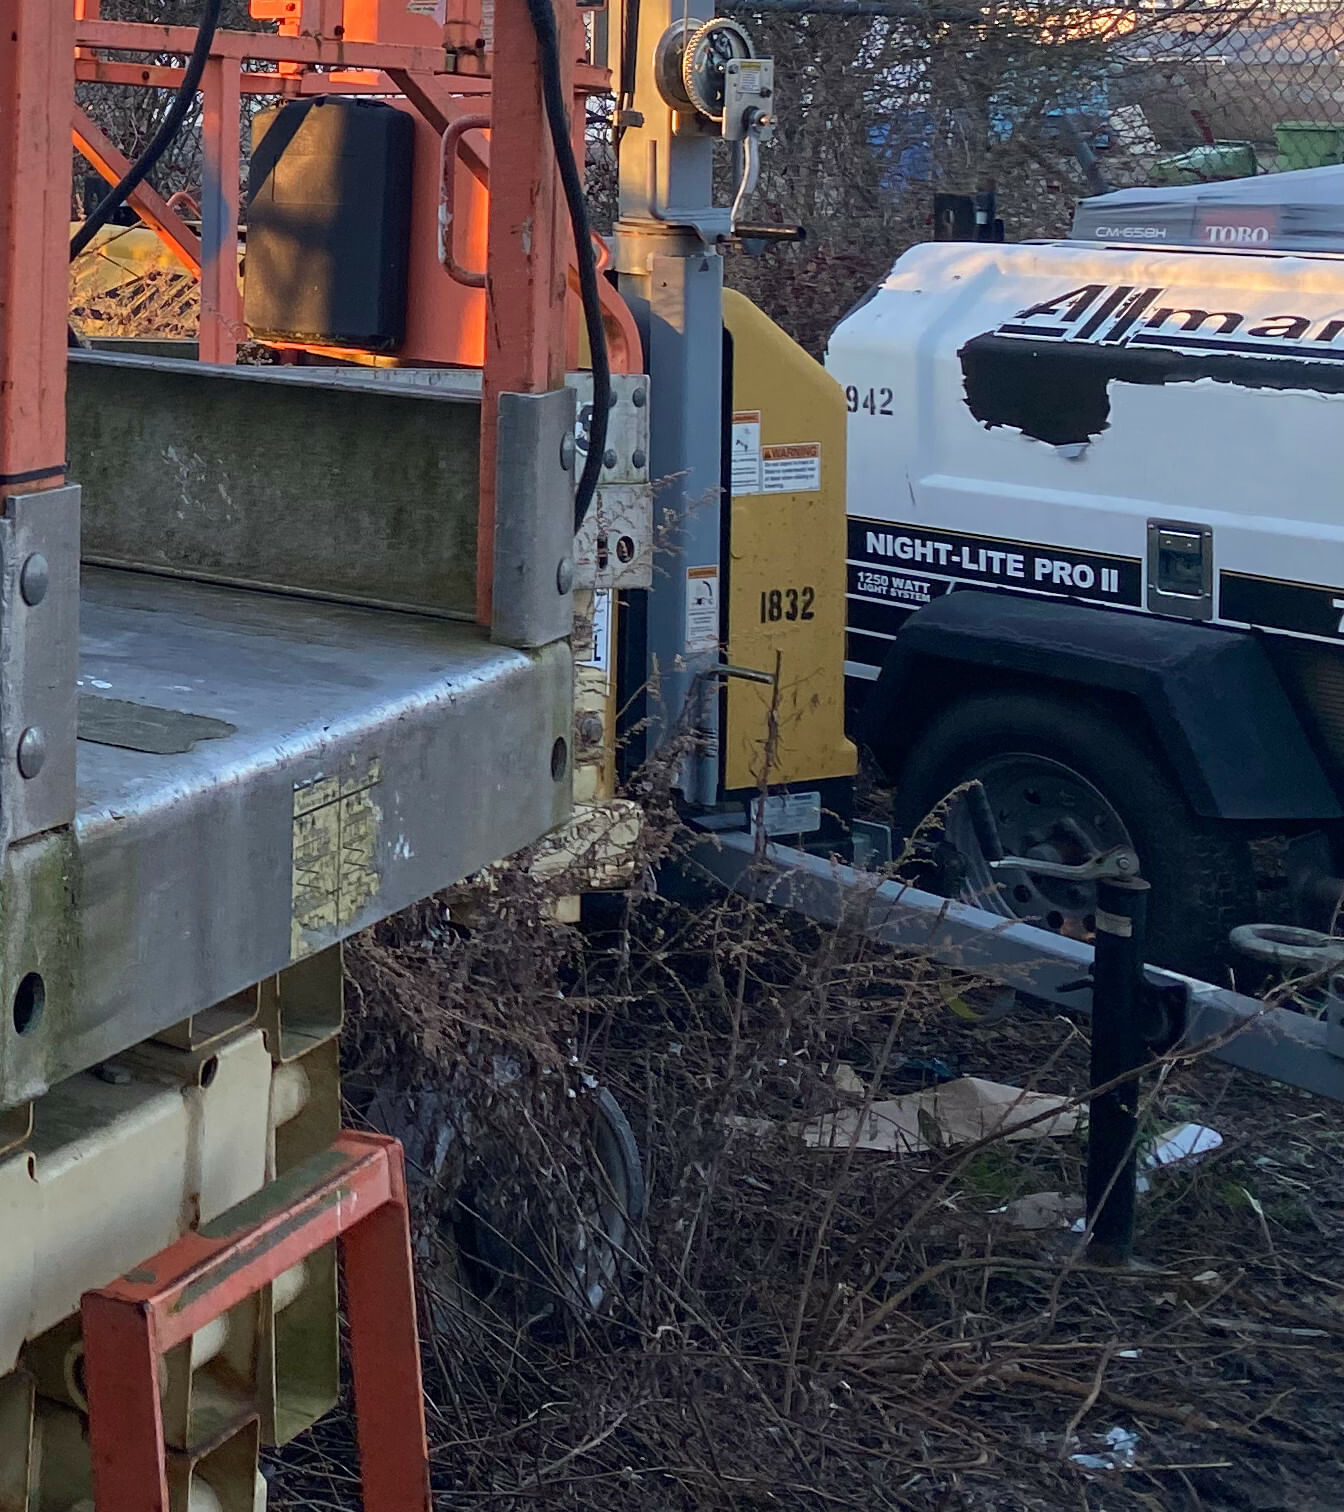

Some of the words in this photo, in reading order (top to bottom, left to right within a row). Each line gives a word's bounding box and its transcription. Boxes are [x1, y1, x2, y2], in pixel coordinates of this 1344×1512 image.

[1095, 226, 1167, 239] CM-658H
[1205, 225, 1270, 243] TORO
[865, 531, 1025, 579] NIGHT-LITE
[1034, 557, 1095, 590] PRO
[1101, 568, 1119, 593] II
[857, 571, 889, 587] 1250
[891, 576, 931, 594] WATT
[857, 581, 888, 595] LIGHT
[890, 587, 931, 603] SYSTEM
[760, 586, 815, 624] 1832
